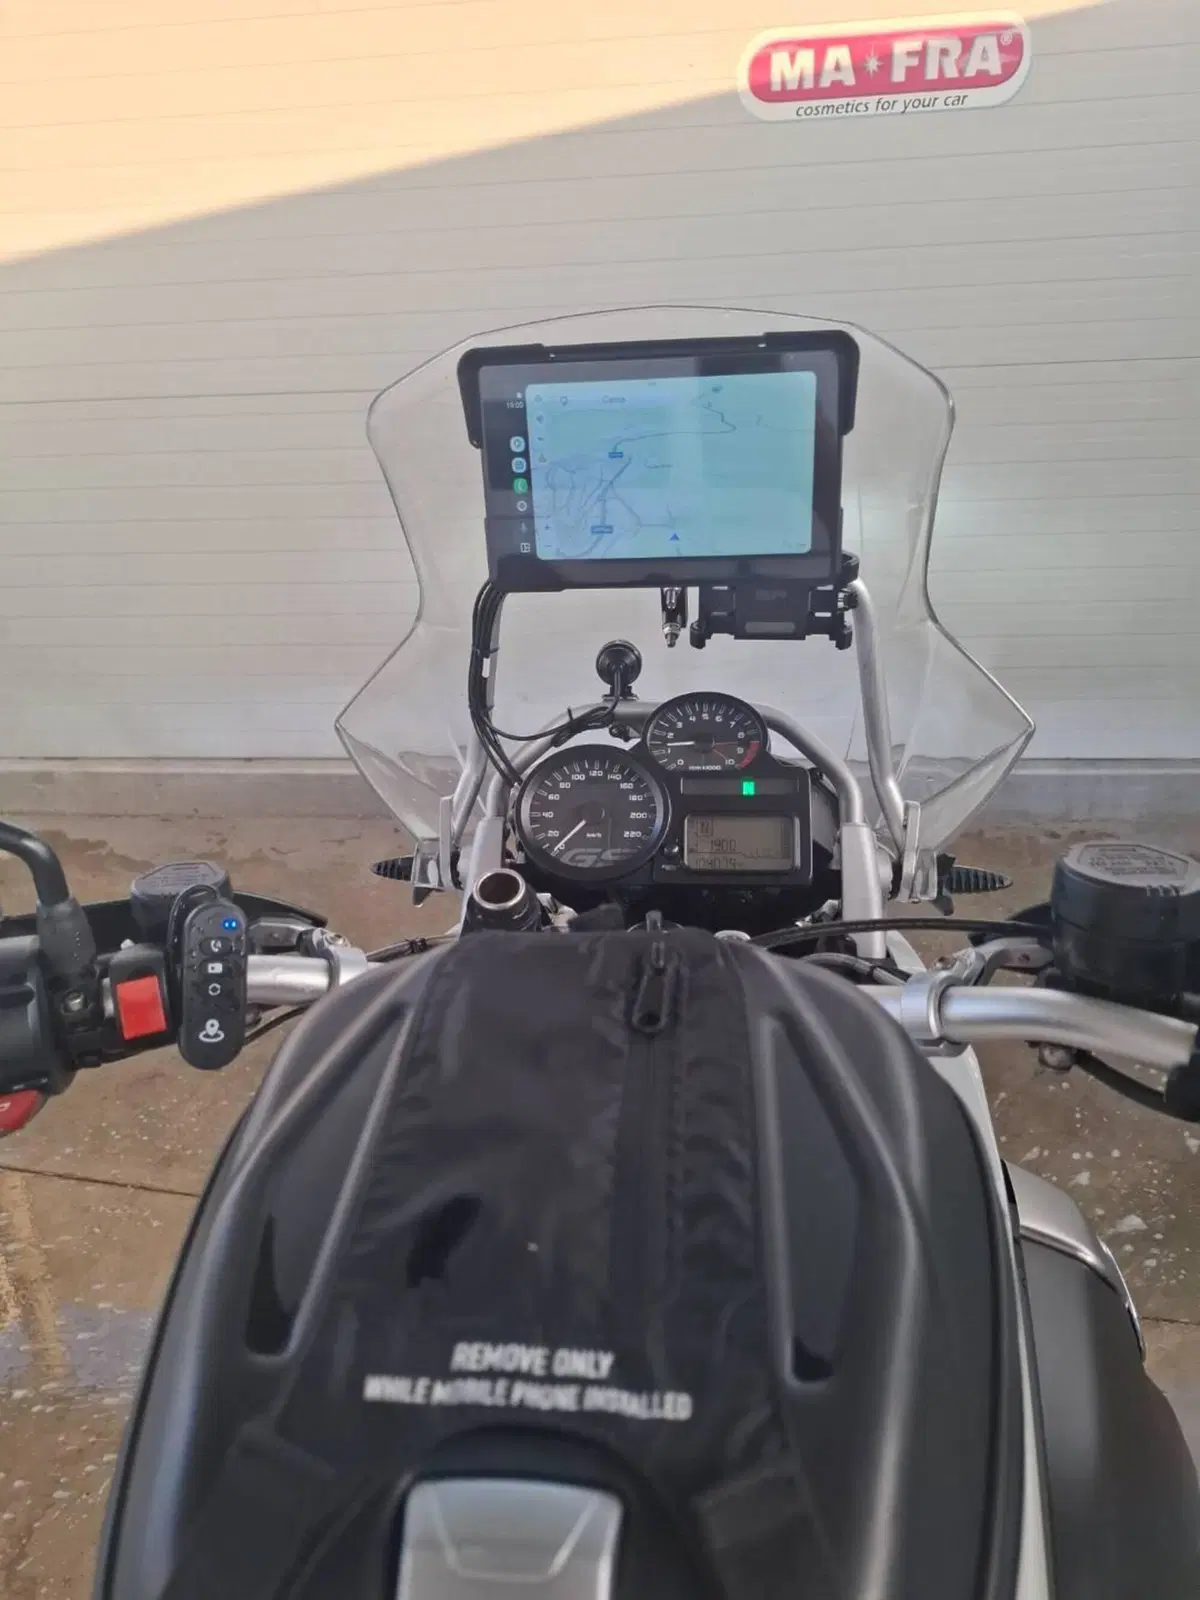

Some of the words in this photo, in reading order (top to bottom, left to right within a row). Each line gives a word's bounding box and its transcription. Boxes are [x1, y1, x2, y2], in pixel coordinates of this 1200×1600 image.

[769, 44, 856, 92] MA
[796, 99, 871, 117] cosmetics
[875, 96, 899, 112] for
[901, 97, 939, 114] your
[943, 93, 969, 106] car
[729, 721, 736, 729] 7
[450, 1341, 550, 1376] REMOVE
[552, 1348, 616, 1379] ONLY
